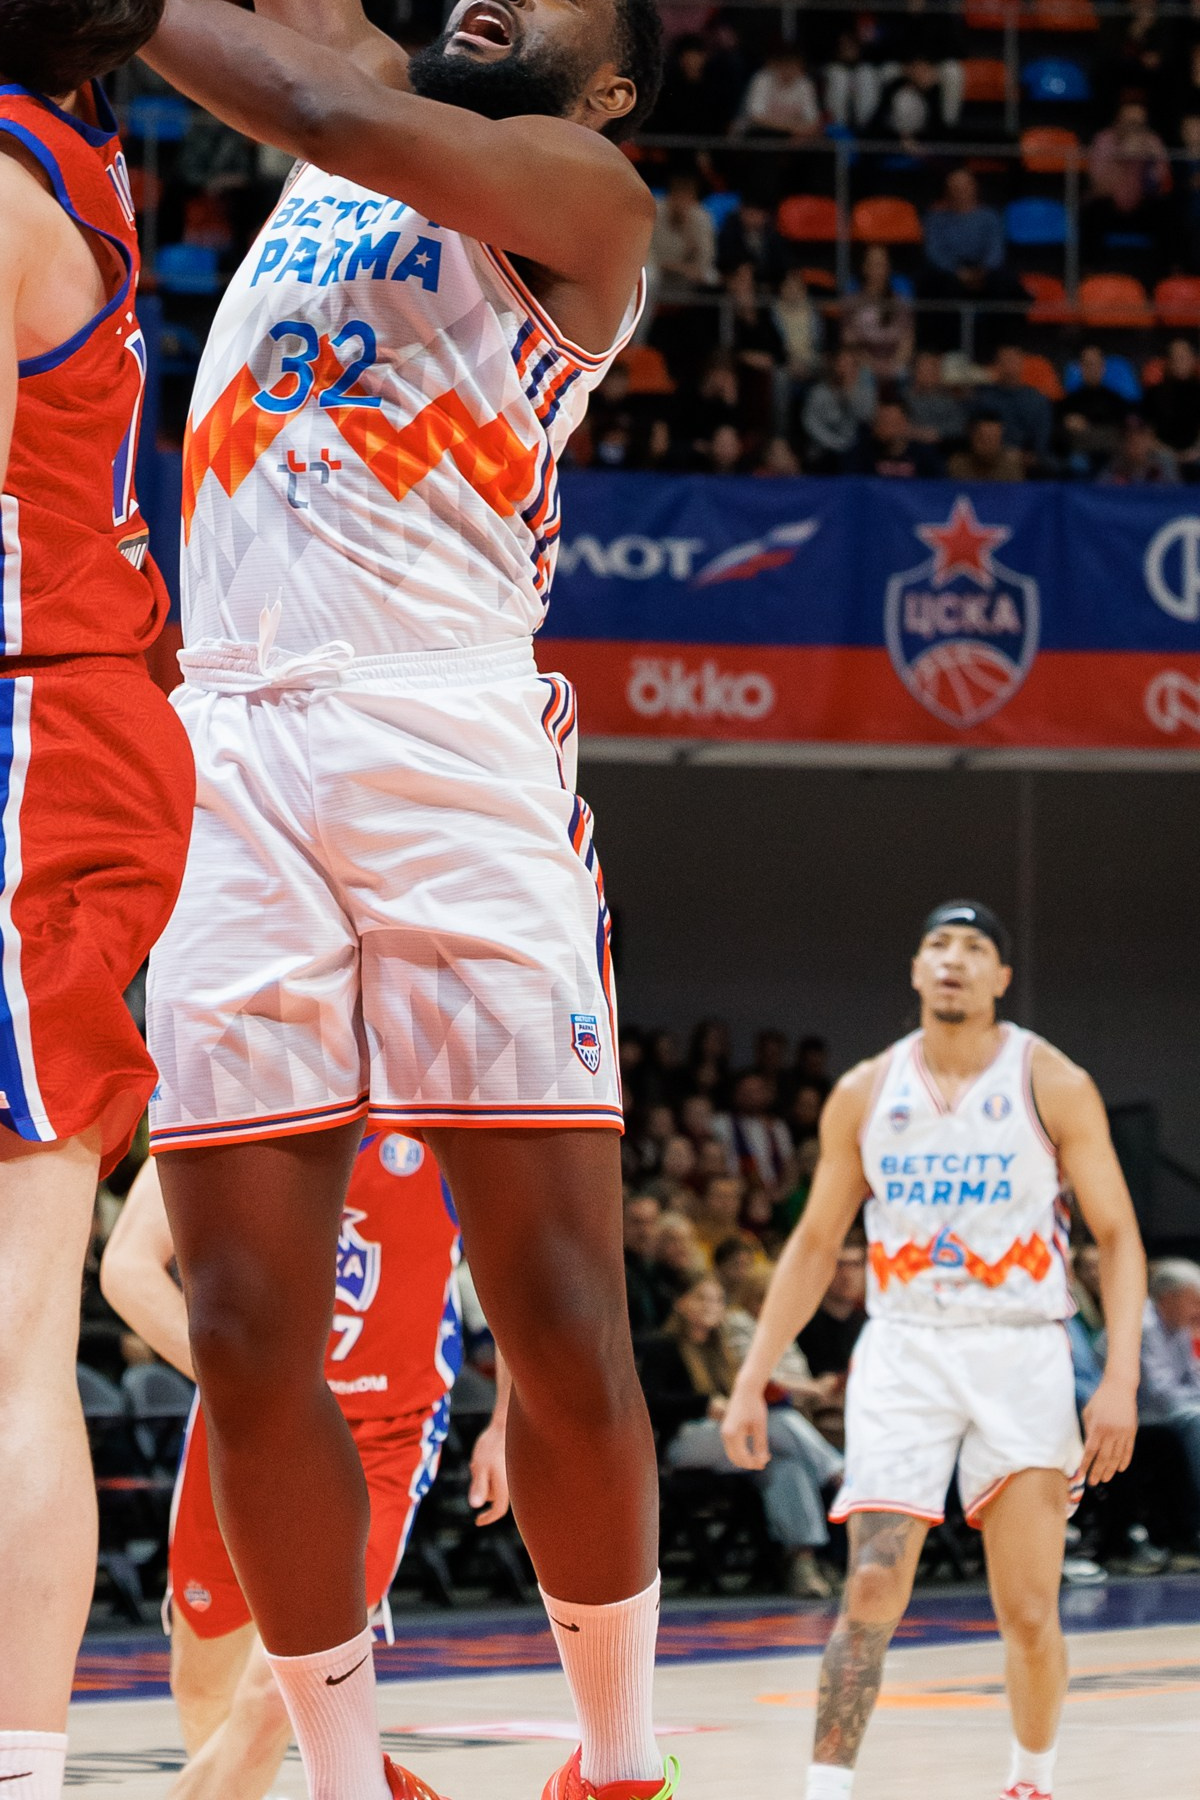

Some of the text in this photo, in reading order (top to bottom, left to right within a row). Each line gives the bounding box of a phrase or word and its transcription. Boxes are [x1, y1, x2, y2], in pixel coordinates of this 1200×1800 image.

[250, 231, 442, 293] PARMA
[251, 320, 383, 414] 32
[903, 592, 1022, 639] ЦСКА
[881, 1153, 1017, 1176] BETCITY
[886, 1180, 1013, 1205] PARMA
[930, 1225, 966, 1268] 6
